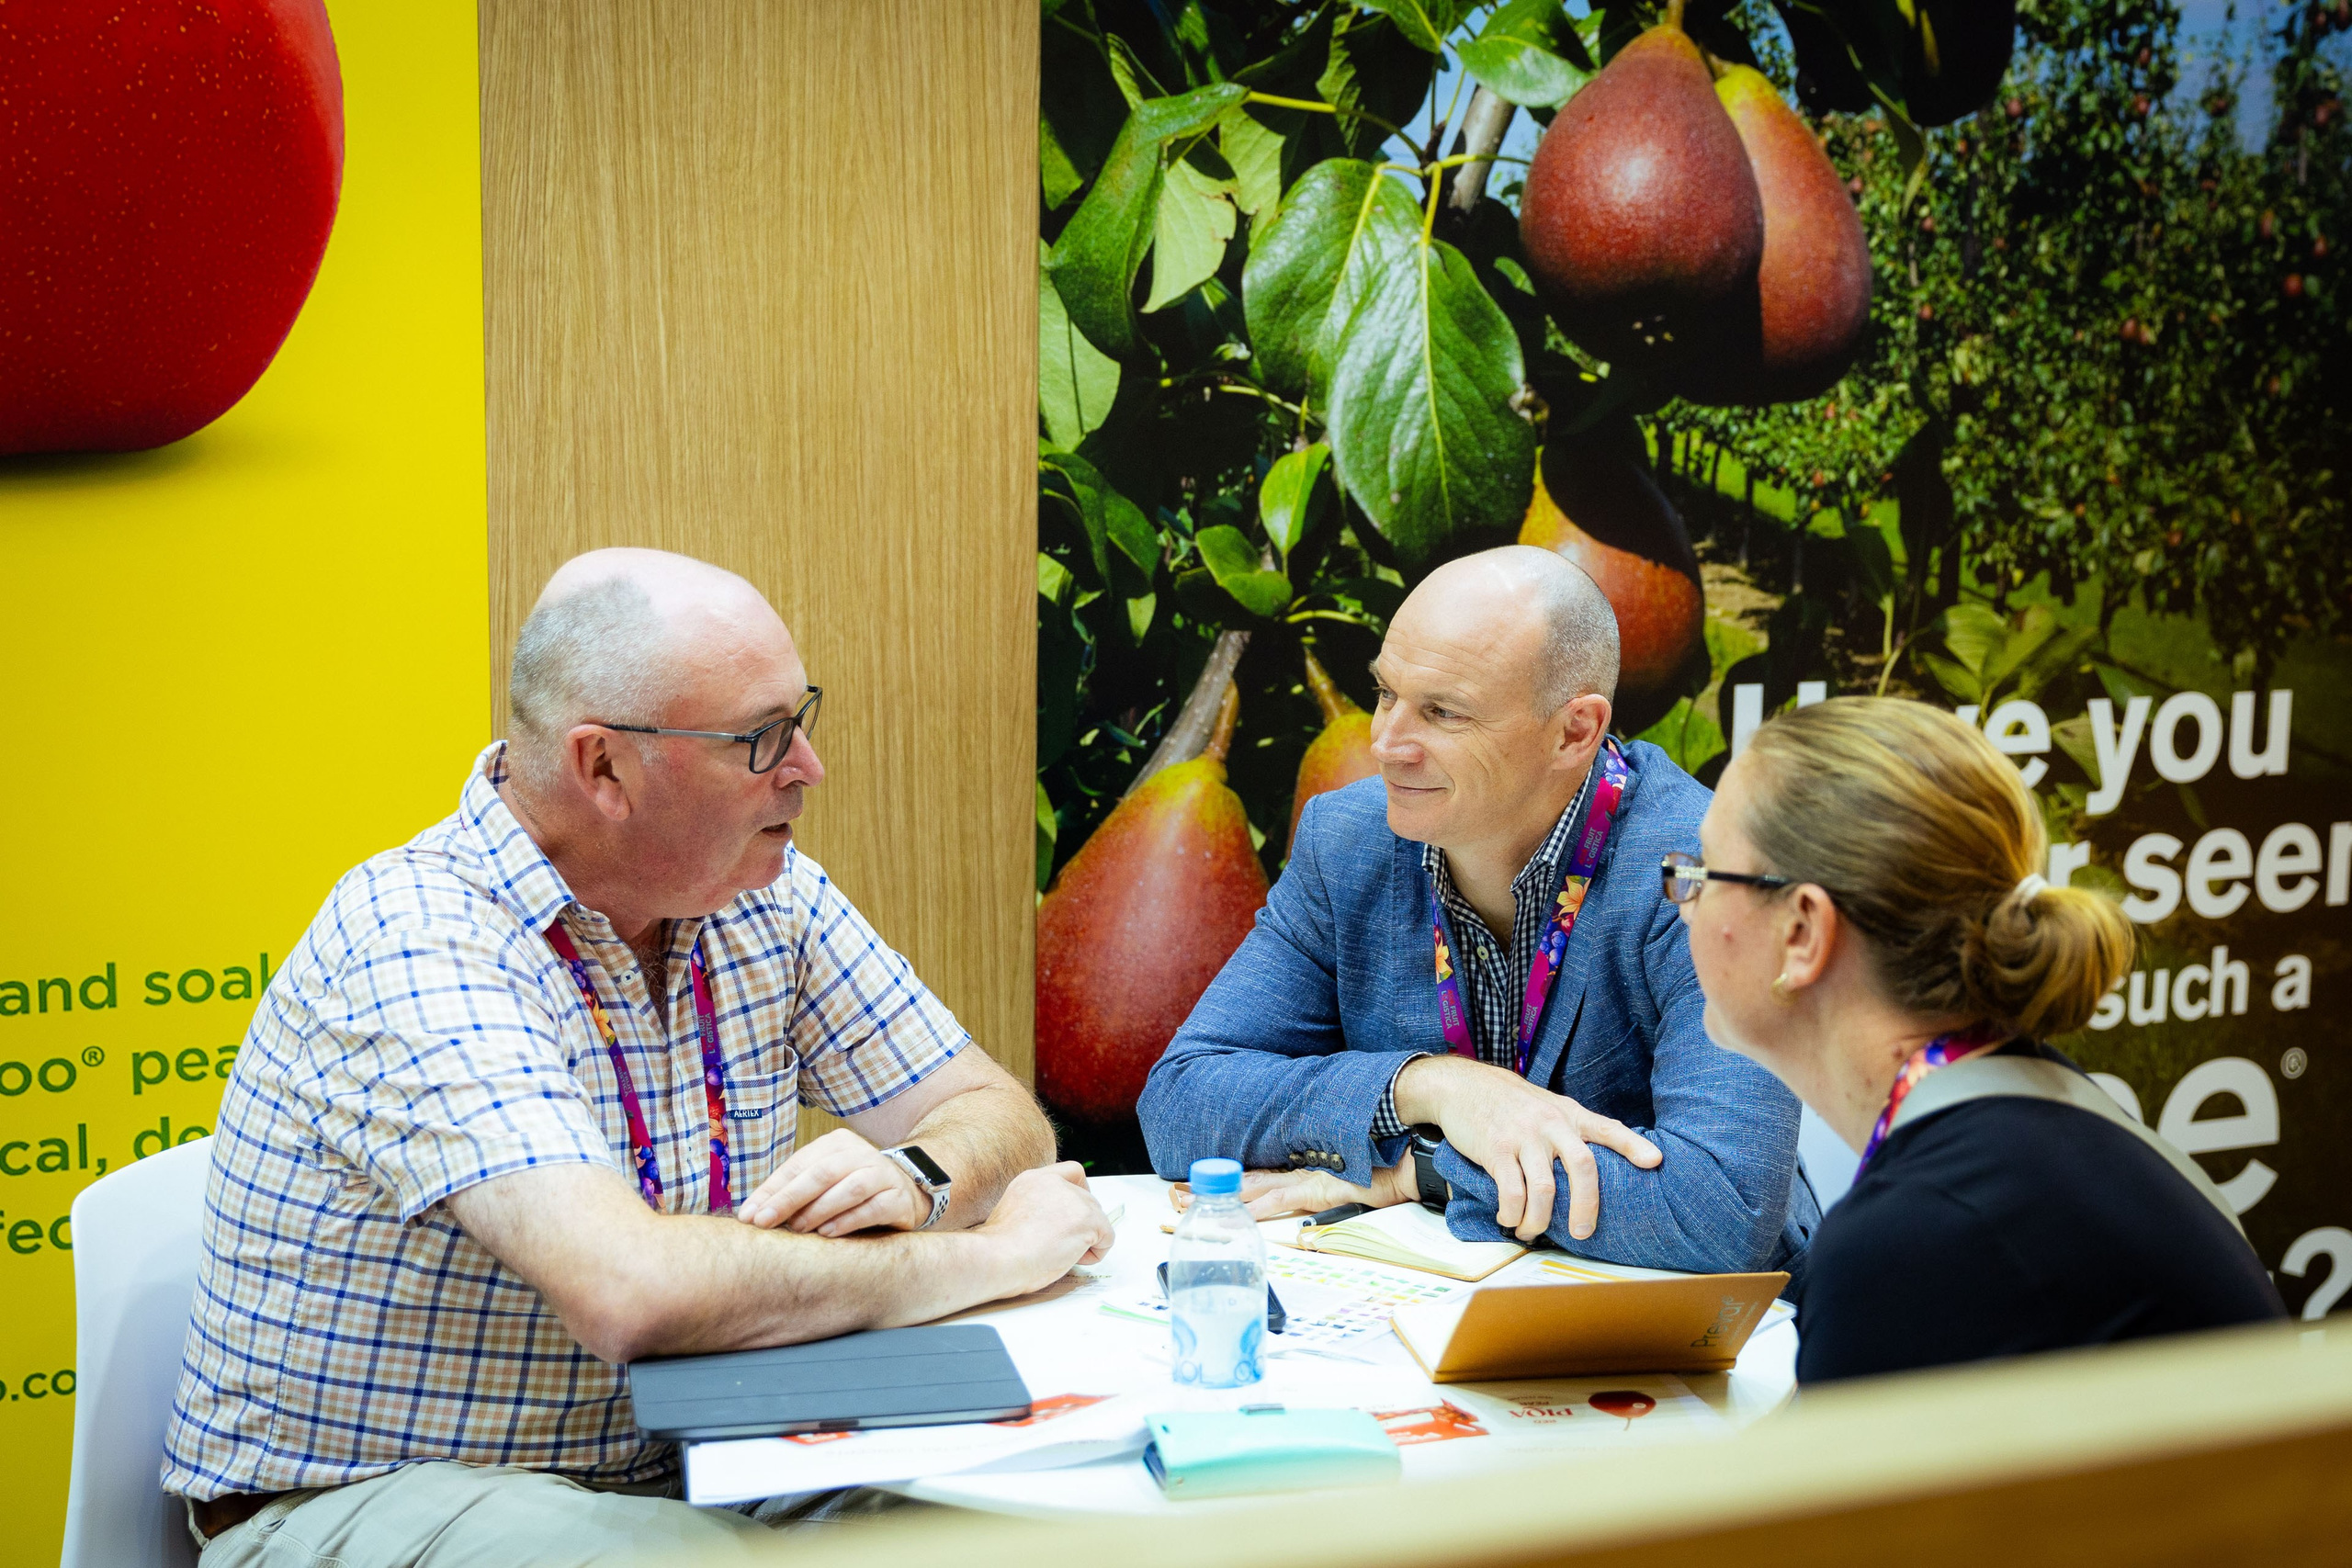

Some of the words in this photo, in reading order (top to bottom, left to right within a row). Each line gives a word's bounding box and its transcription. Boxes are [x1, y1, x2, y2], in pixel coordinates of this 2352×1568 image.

[2086, 689, 2294, 816] you
[1583, 827, 1596, 850] FRUIT
[0, 962, 118, 1016] and
[2270, 953, 2312, 1012] a
[1450, 1005, 1460, 1026] FRUIT
[1523, 1003, 1532, 1025] FRUIT
[733, 1109, 760, 1119] AERTEX
